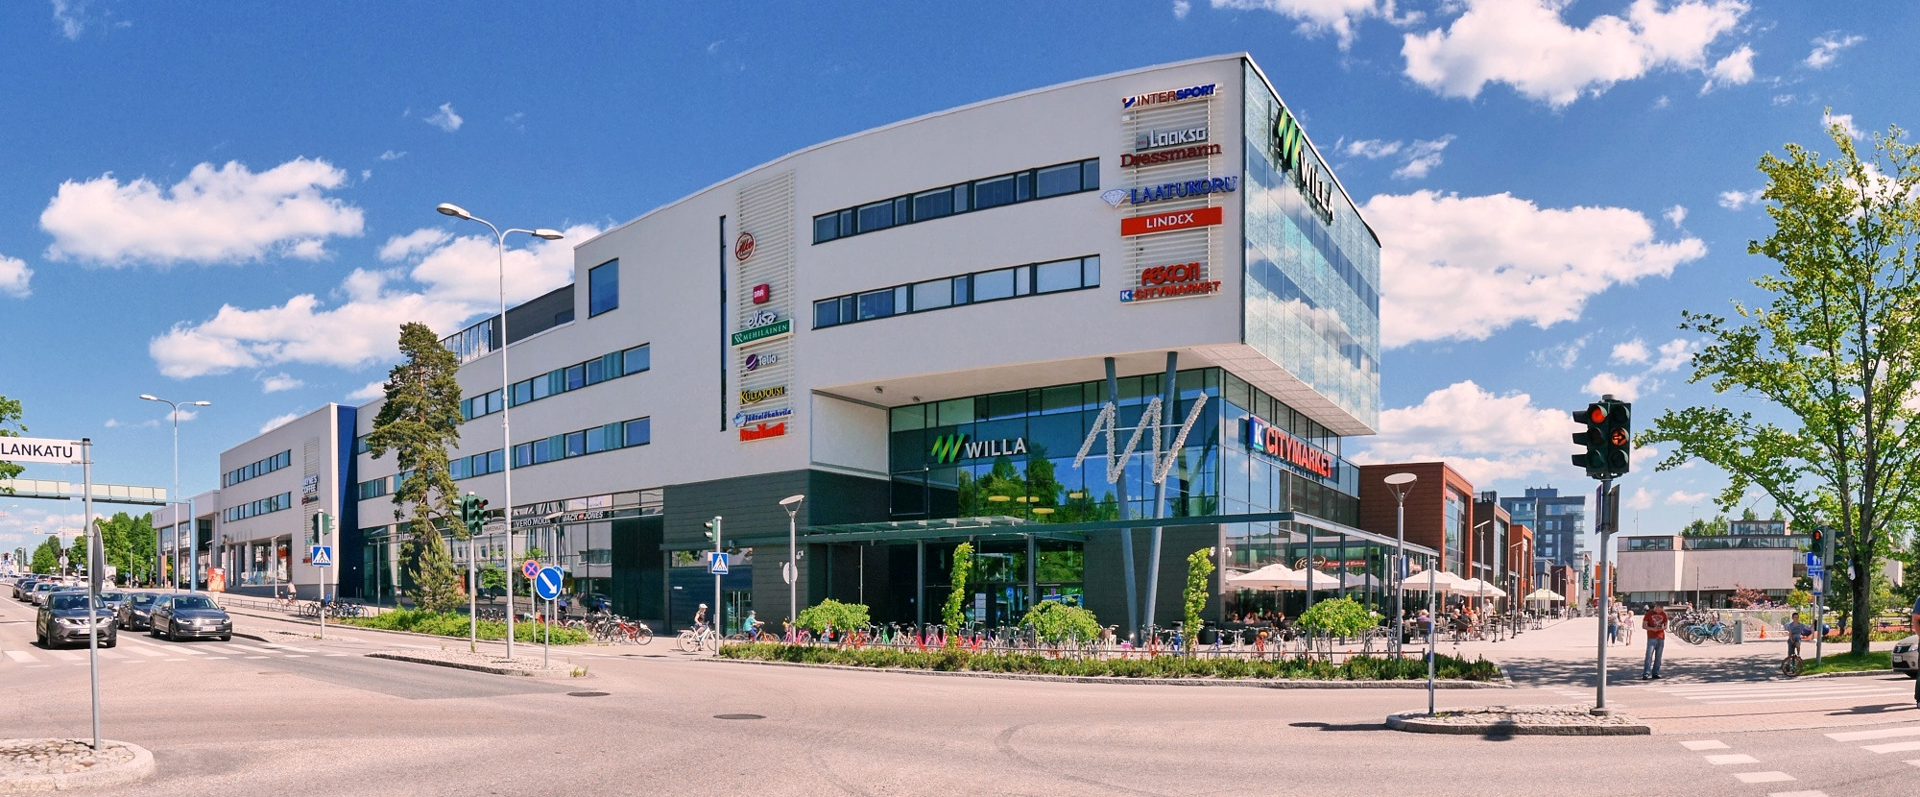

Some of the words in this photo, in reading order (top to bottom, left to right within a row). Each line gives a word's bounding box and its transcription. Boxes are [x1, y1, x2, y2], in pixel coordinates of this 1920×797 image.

[1136, 83, 1216, 106] INTERSPORT
[1150, 127, 1207, 148] Laakso
[1120, 144, 1222, 167] Dressmann
[1130, 176, 1237, 205] LAATUKORU
[1299, 149, 1335, 220] WILLA
[1146, 213, 1194, 229] LINDEX
[1134, 280, 1221, 300] CITYMARKET
[748, 310, 777, 329] elisa
[758, 353, 777, 366] Telia
[739, 385, 784, 405] KULTAJOUSI
[1, 442, 73, 459] LANKATU
[965, 437, 1027, 459] WILLA
[1265, 426, 1332, 478] CITYMARKET
